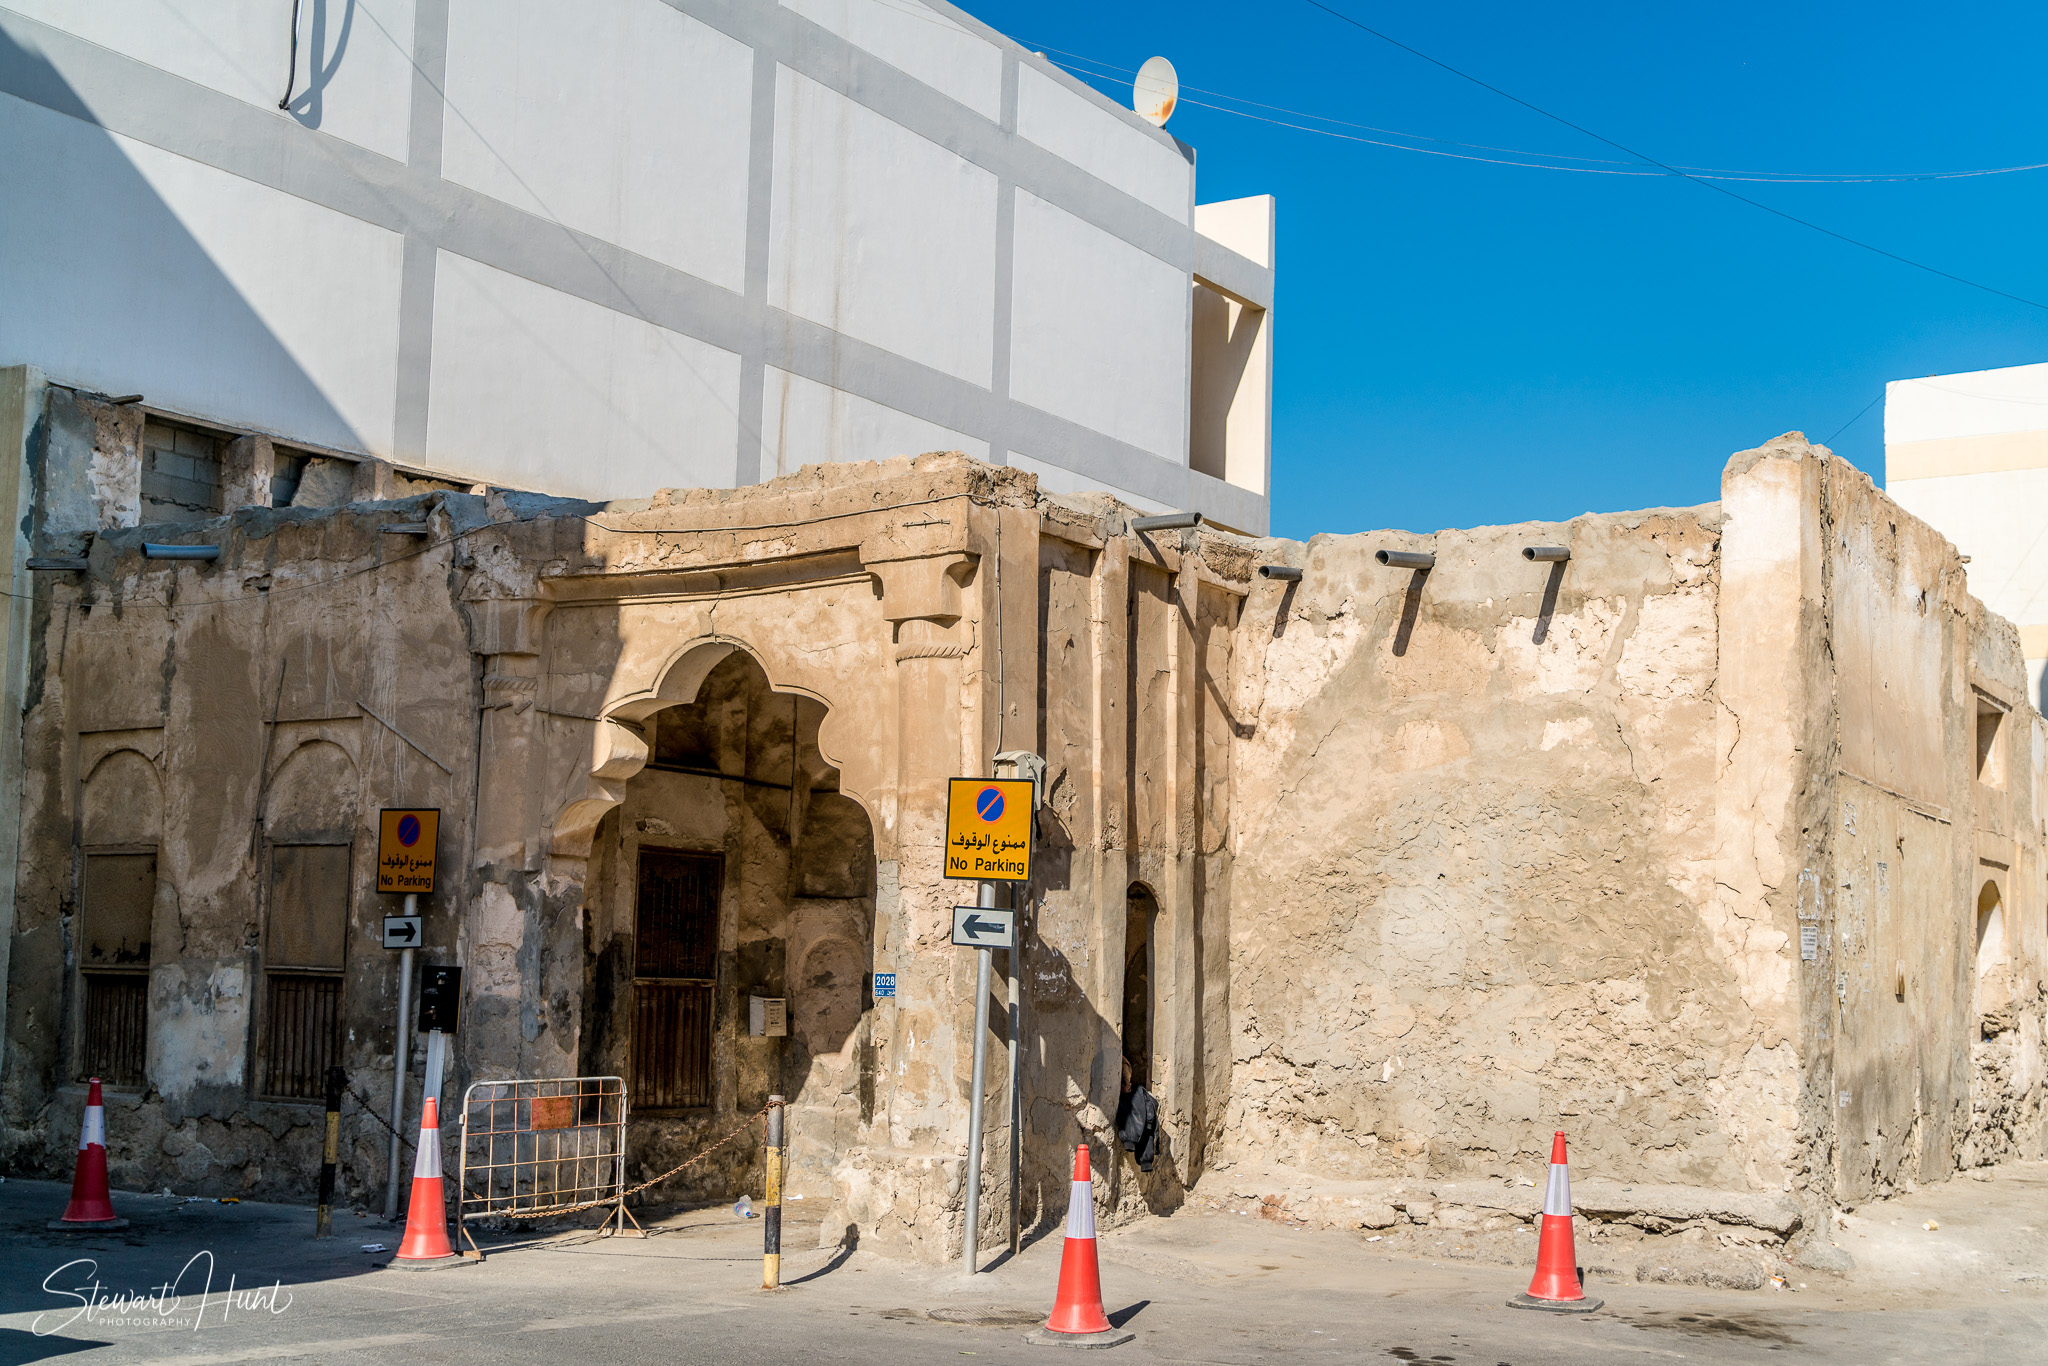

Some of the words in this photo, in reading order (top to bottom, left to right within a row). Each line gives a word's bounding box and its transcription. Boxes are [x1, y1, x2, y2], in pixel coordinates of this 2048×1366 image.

[951, 832, 990, 850] الوقوف
[992, 834, 1026, 854] ممنوع
[381, 853, 409, 869] الوقوف
[409, 855, 432, 872] ممنوع
[950, 856, 968, 870] No
[975, 857, 1025, 875] Parking
[380, 874, 394, 886] No
[397, 874, 432, 889] Parking
[876, 976, 895, 986] 2028
